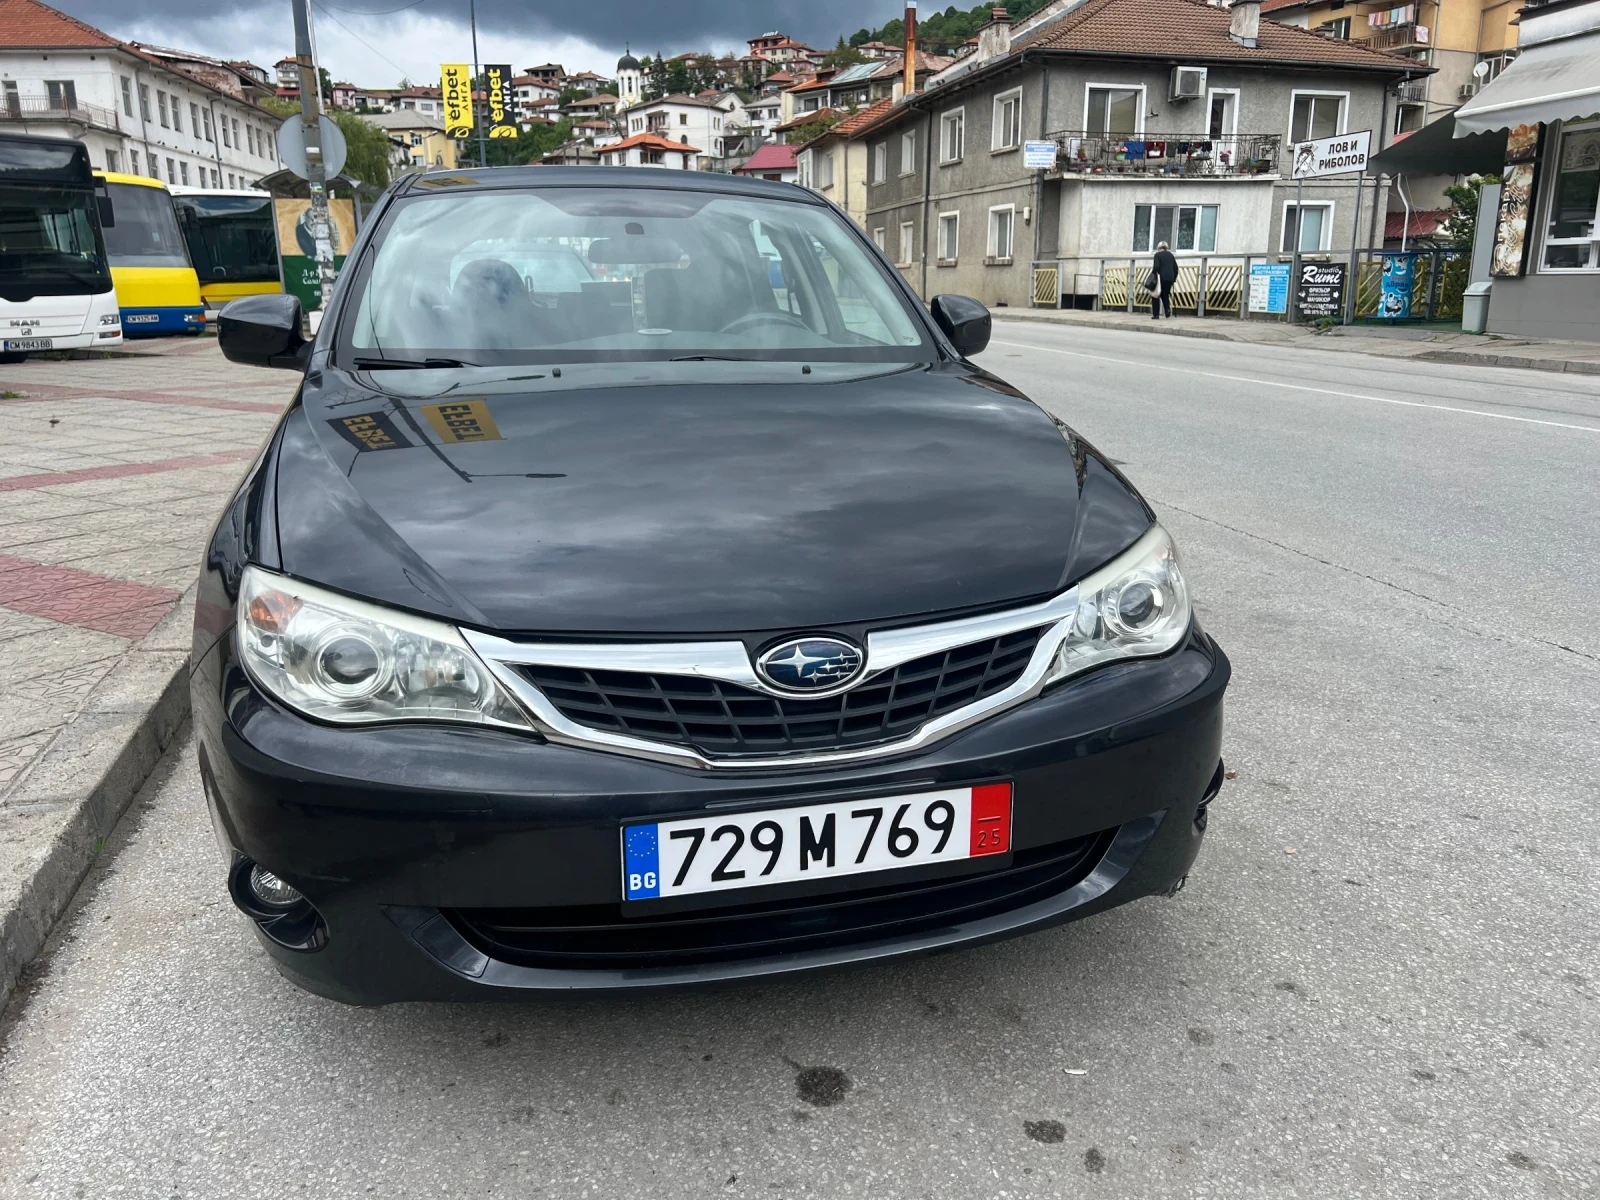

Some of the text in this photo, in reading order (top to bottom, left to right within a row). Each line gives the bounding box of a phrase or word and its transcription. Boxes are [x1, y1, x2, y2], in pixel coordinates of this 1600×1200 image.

[445, 69, 461, 121] efbet
[460, 81, 469, 112] ЛИГА
[487, 68, 505, 121] efbet
[503, 81, 512, 112] ЛИГА
[1328, 140, 1358, 155] ЛОВ И
[1319, 154, 1365, 170] РИБОЛОВ
[1497, 174, 1512, 242] пекарн
[1301, 265, 1342, 284] Rumi
[1317, 266, 1340, 274] studio
[9, 319, 41, 327] MAN
[977, 828, 1001, 849] 25
[629, 872, 657, 891] BG
